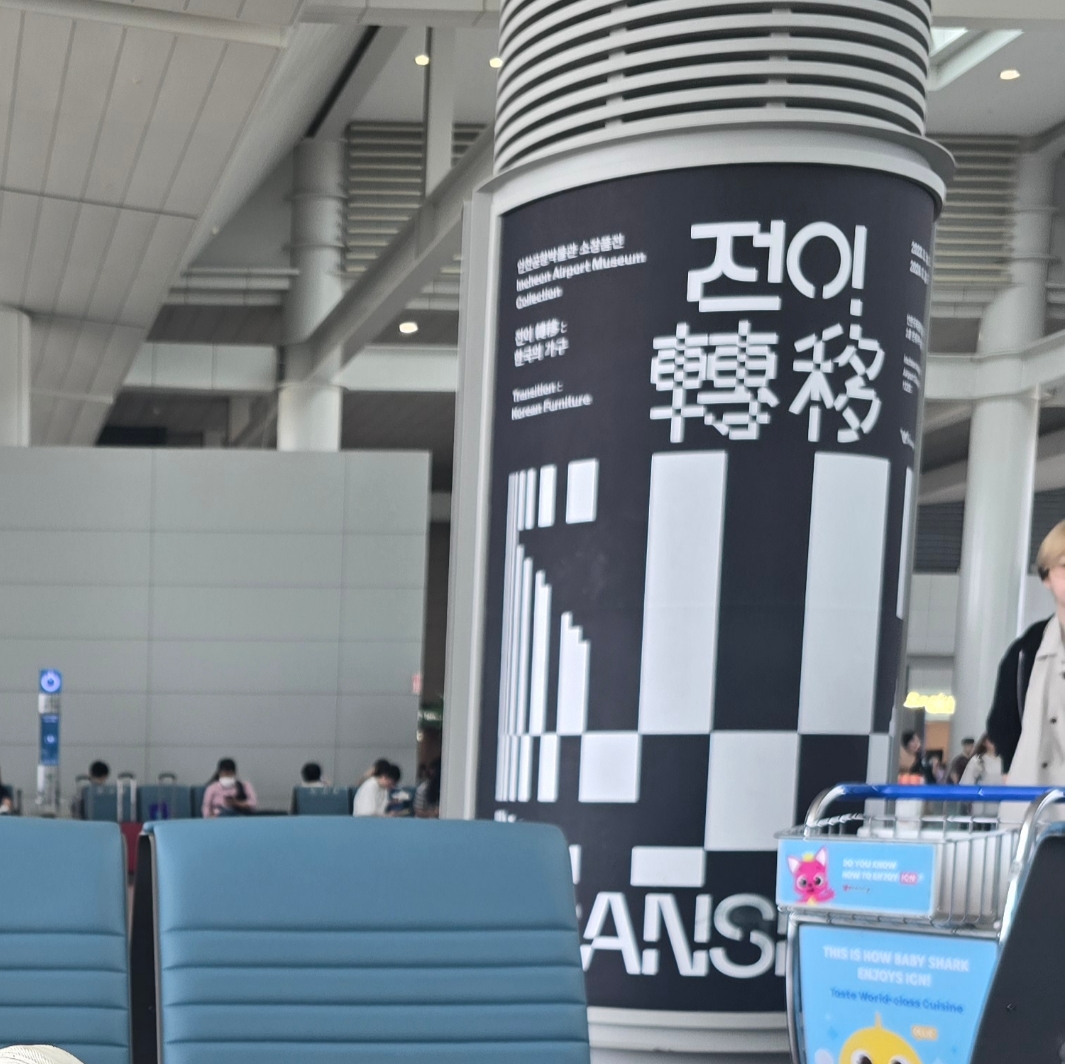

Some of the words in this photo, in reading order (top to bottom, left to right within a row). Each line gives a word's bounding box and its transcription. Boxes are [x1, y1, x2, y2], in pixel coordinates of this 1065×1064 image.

[516, 270, 552, 292] Incheon
[552, 258, 592, 279] Airport
[592, 251, 647, 271] Museum
[516, 285, 563, 310] Collection
[511, 402, 543, 420] Korean
[543, 392, 593, 413] Furniture
[842, 870, 861, 880] HOW
[862, 871, 872, 881] TO
[873, 872, 898, 882] ENJOY
[855, 859, 872, 869] YOU
[872, 860, 898, 870] KNOW
[823, 946, 848, 960] THIS
[849, 948, 861, 962] IS
[862, 949, 893, 964] HOW
[894, 954, 926, 968] BABY
[928, 958, 969, 972] SHARK
[858, 967, 903, 984] ENJOYS
[830, 987, 858, 1001] Taste
[858, 991, 921, 1009] World-class
[921, 998, 964, 1014] Cuisine
